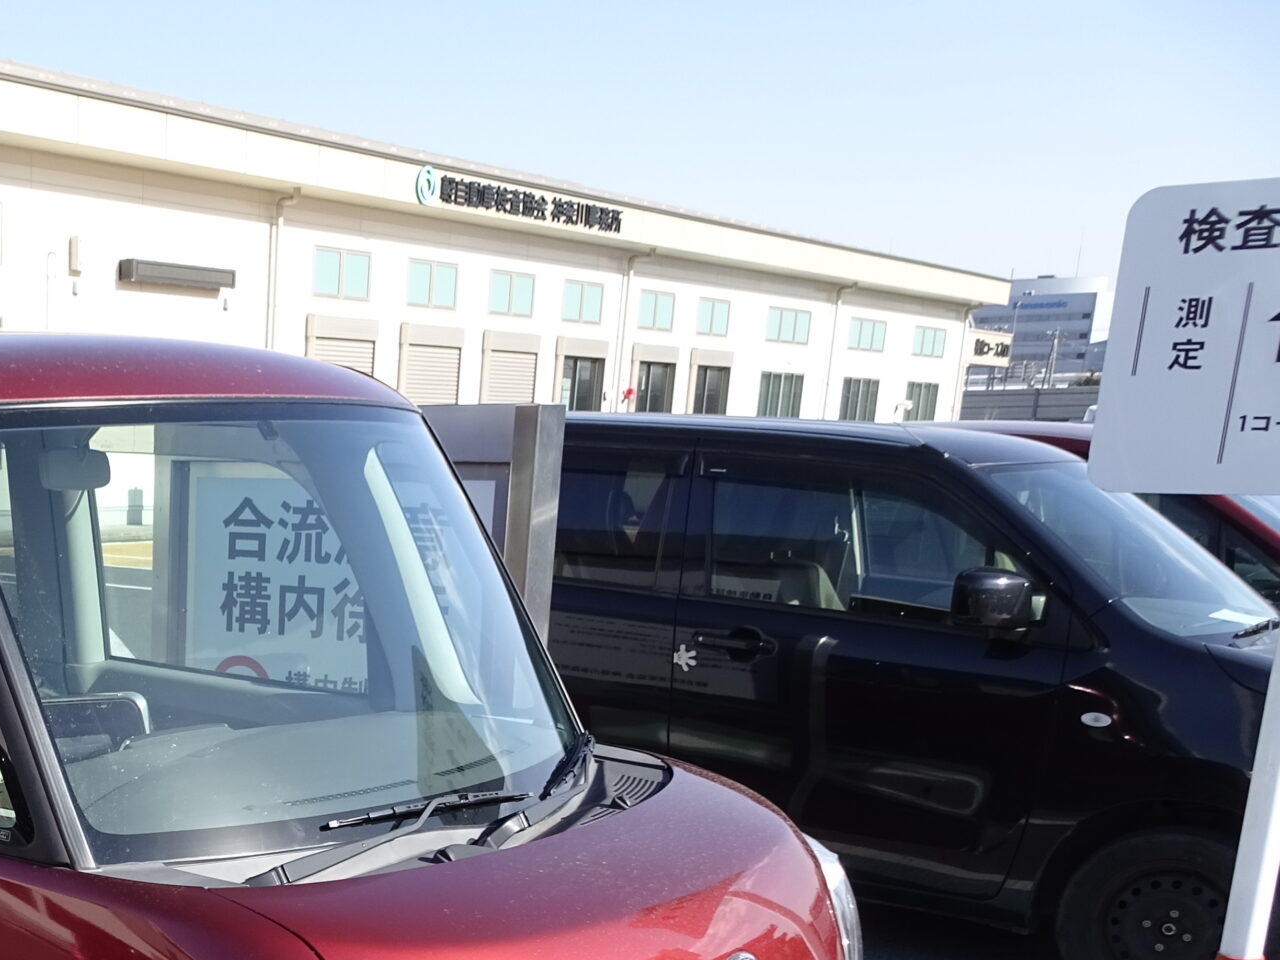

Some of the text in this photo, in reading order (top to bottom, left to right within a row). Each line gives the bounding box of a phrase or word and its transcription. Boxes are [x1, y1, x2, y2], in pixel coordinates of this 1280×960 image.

[1178, 205, 1280, 255] 検査
[1167, 297, 1214, 371] 測定
[1238, 414, 1280, 432] 1コ
